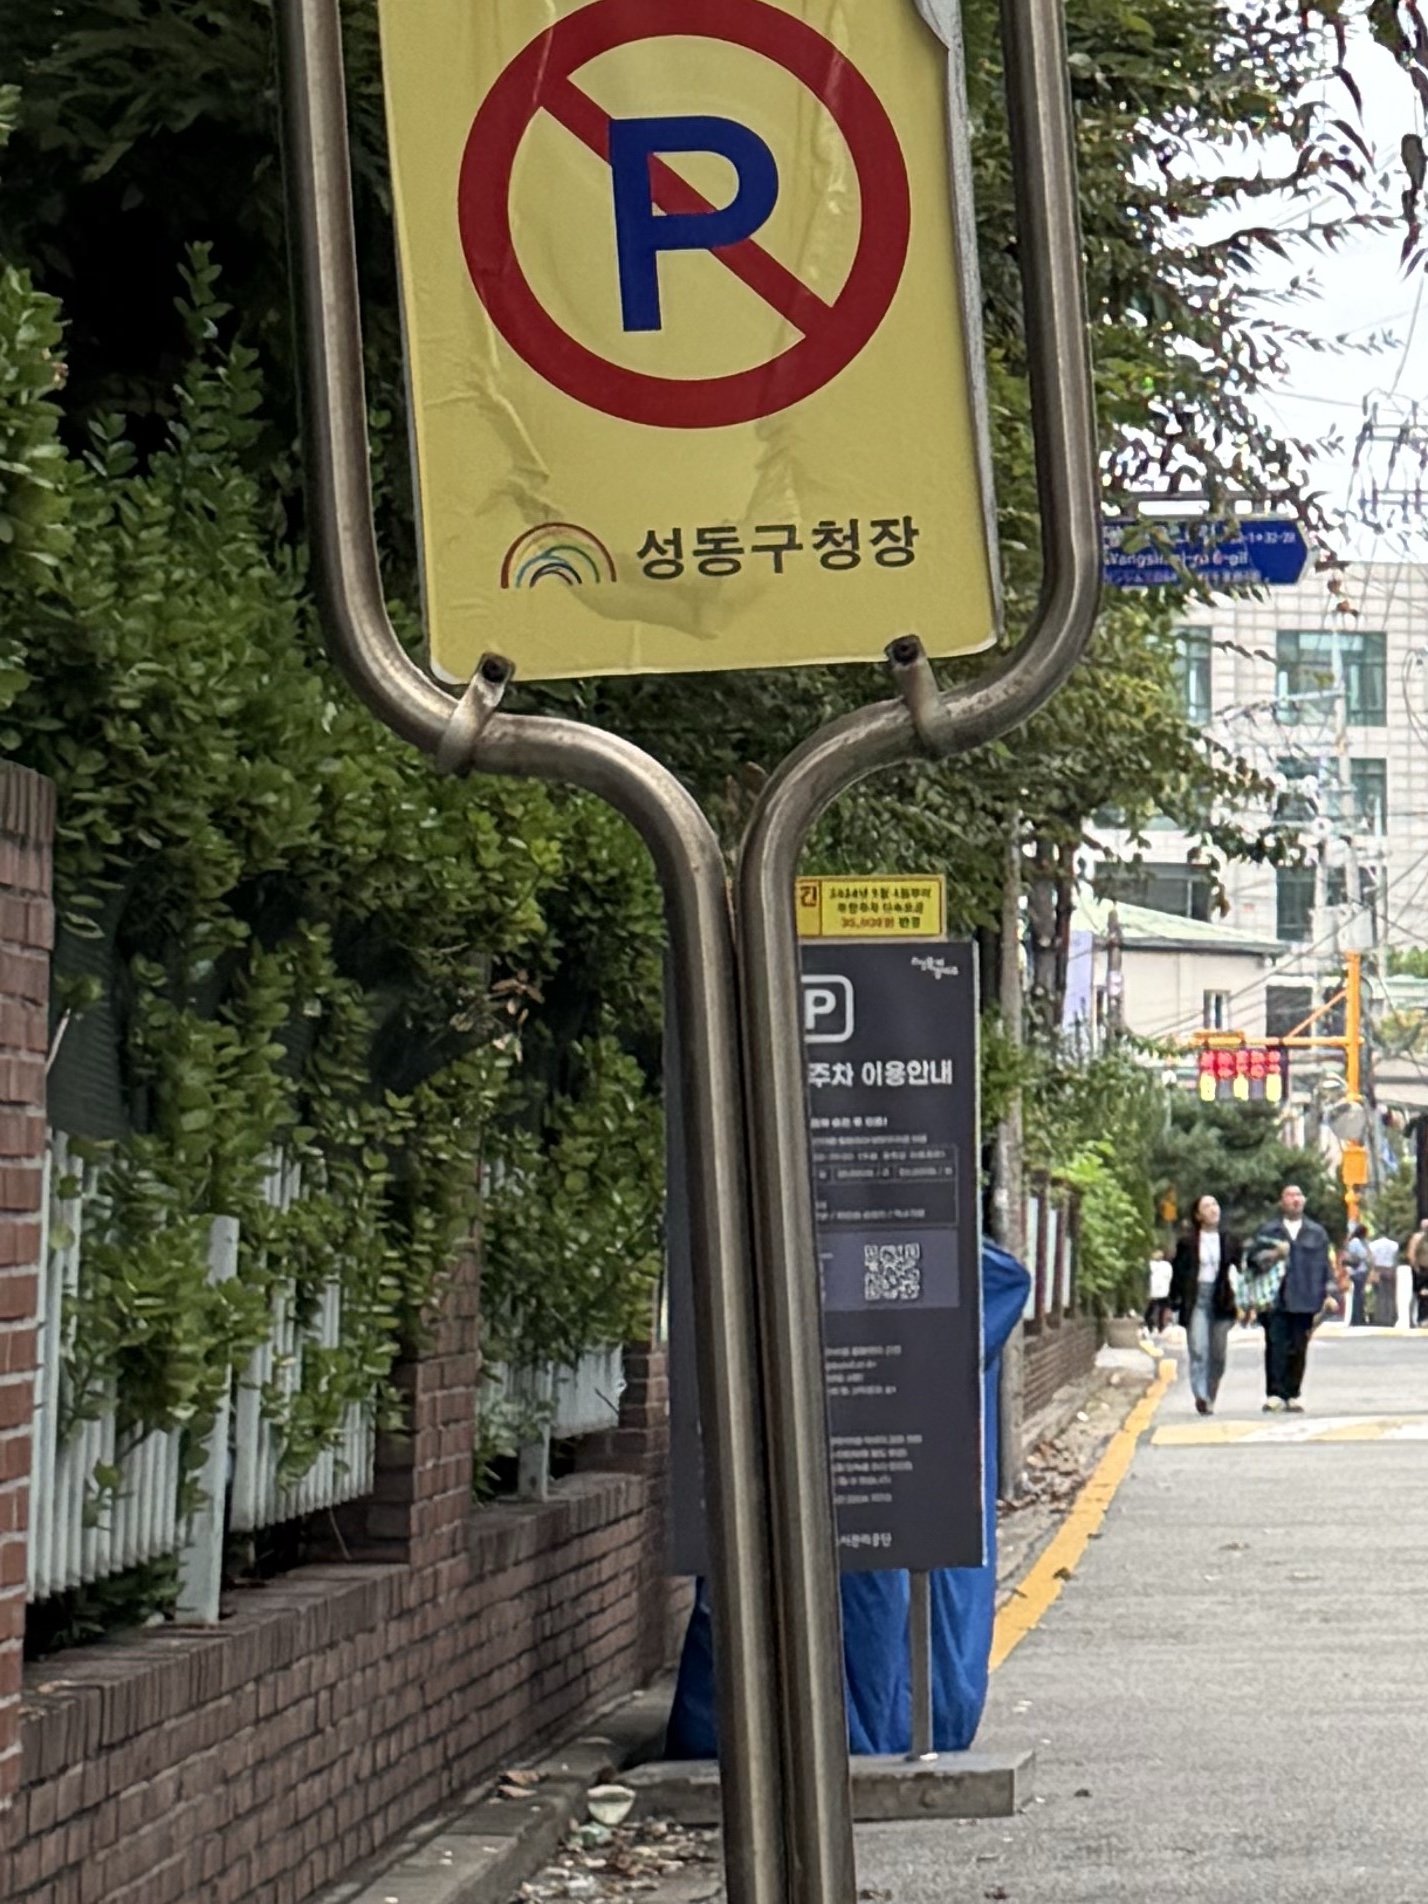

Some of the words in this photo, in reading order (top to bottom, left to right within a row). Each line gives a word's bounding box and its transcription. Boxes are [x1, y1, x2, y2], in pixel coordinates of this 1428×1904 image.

[609, 115, 779, 332] P
[636, 514, 920, 580] 성동구청장
[804, 988, 836, 1030] P
[861, 1059, 953, 1086] 이용안내
